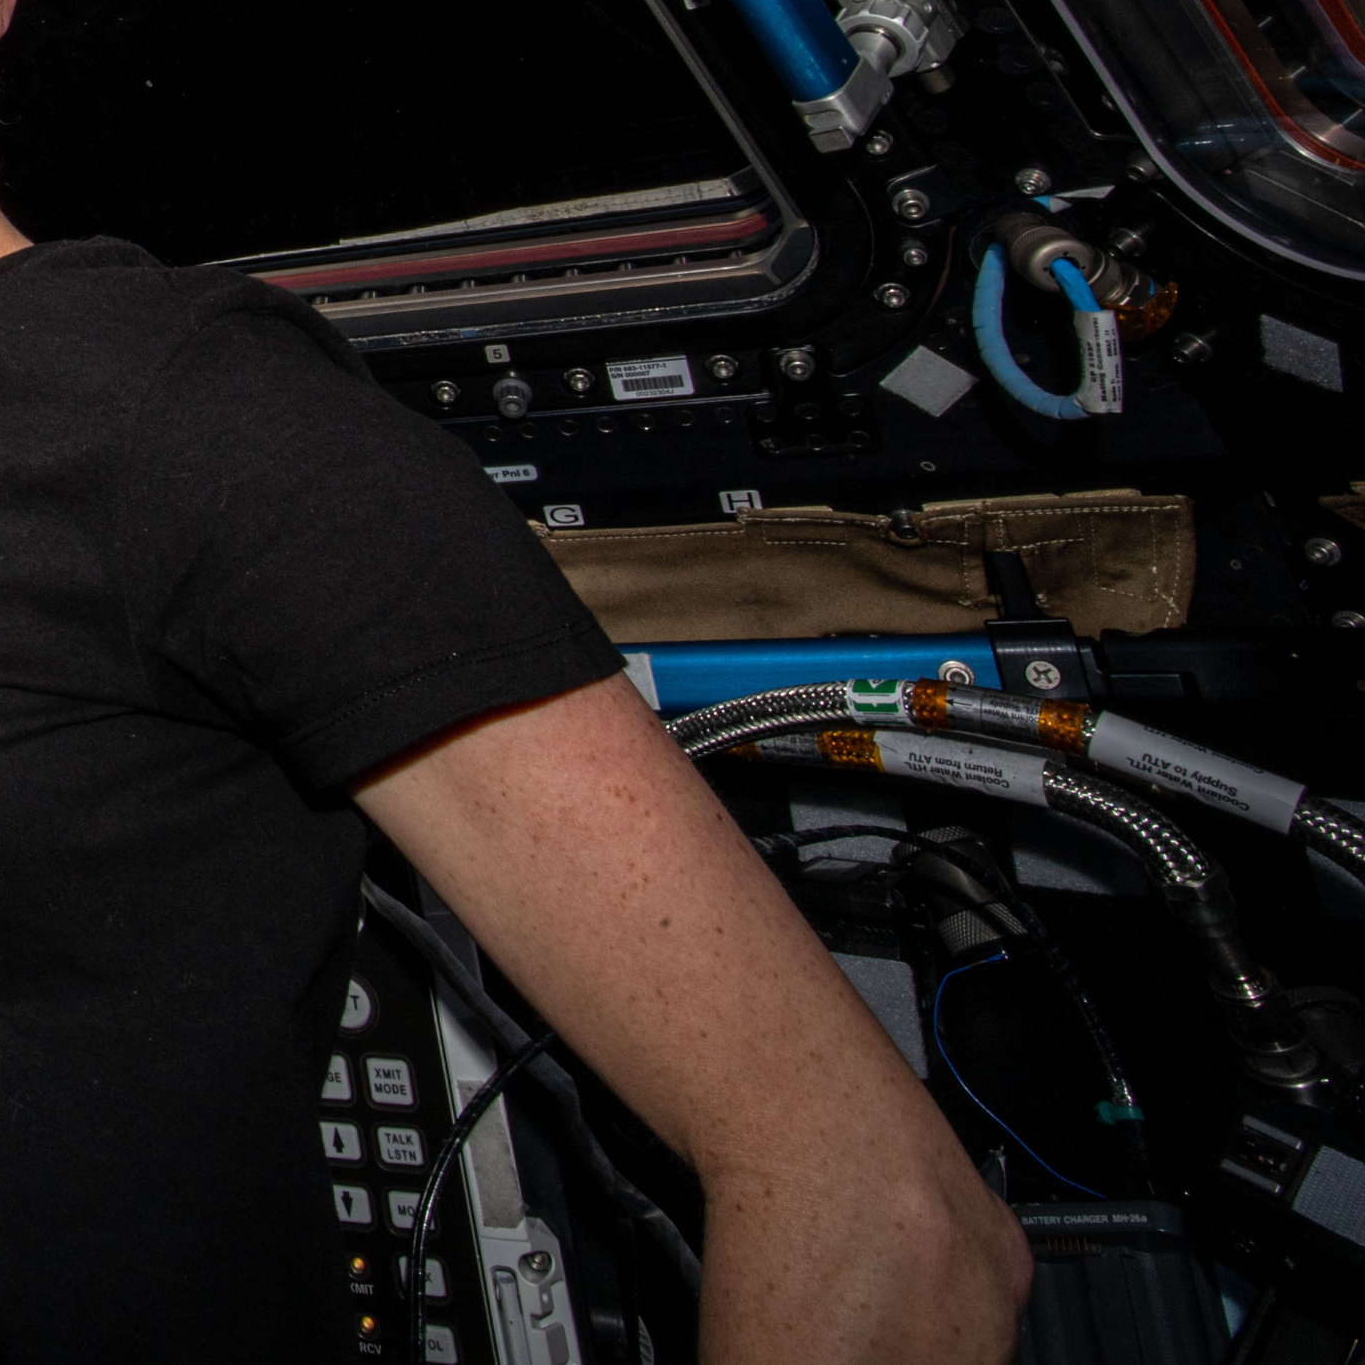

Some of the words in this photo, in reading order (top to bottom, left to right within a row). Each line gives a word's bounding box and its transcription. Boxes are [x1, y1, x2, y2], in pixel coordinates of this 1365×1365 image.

[492, 348, 503, 359] 5
[609, 365, 622, 374] P/N
[623, 363, 667, 373] 683-11577-1
[1099, 372, 1108, 403] Mating
[502, 469, 521, 479] Pnl
[522, 469, 531, 477] 6
[726, 491, 755, 511] H
[549, 506, 580, 525] G
[908, 752, 933, 765] ATU
[934, 756, 962, 769] from
[1125, 756, 1153, 774] HTL
[1141, 753, 1171, 770] ATU
[904, 760, 928, 773] HTL
[929, 765, 963, 780] Water
[964, 761, 1003, 778] Return
[1173, 764, 1188, 777] to
[964, 772, 1010, 789] Coolant
[1155, 768, 1194, 790] Water
[1190, 770, 1238, 797] Supply
[1196, 784, 1250, 812] Coolant
[373, 1067, 402, 1081] XMIT
[373, 1083, 408, 1096] MODE
[384, 1132, 415, 1146] TALK
[386, 1149, 417, 1163] LSTN
[1021, 1215, 1061, 1225] BATTERY
[1063, 1214, 1109, 1224] CHARGER
[1112, 1213, 1148, 1223] MH-26a
[359, 1342, 382, 1356] RCV
[428, 1339, 444, 1351] OL
